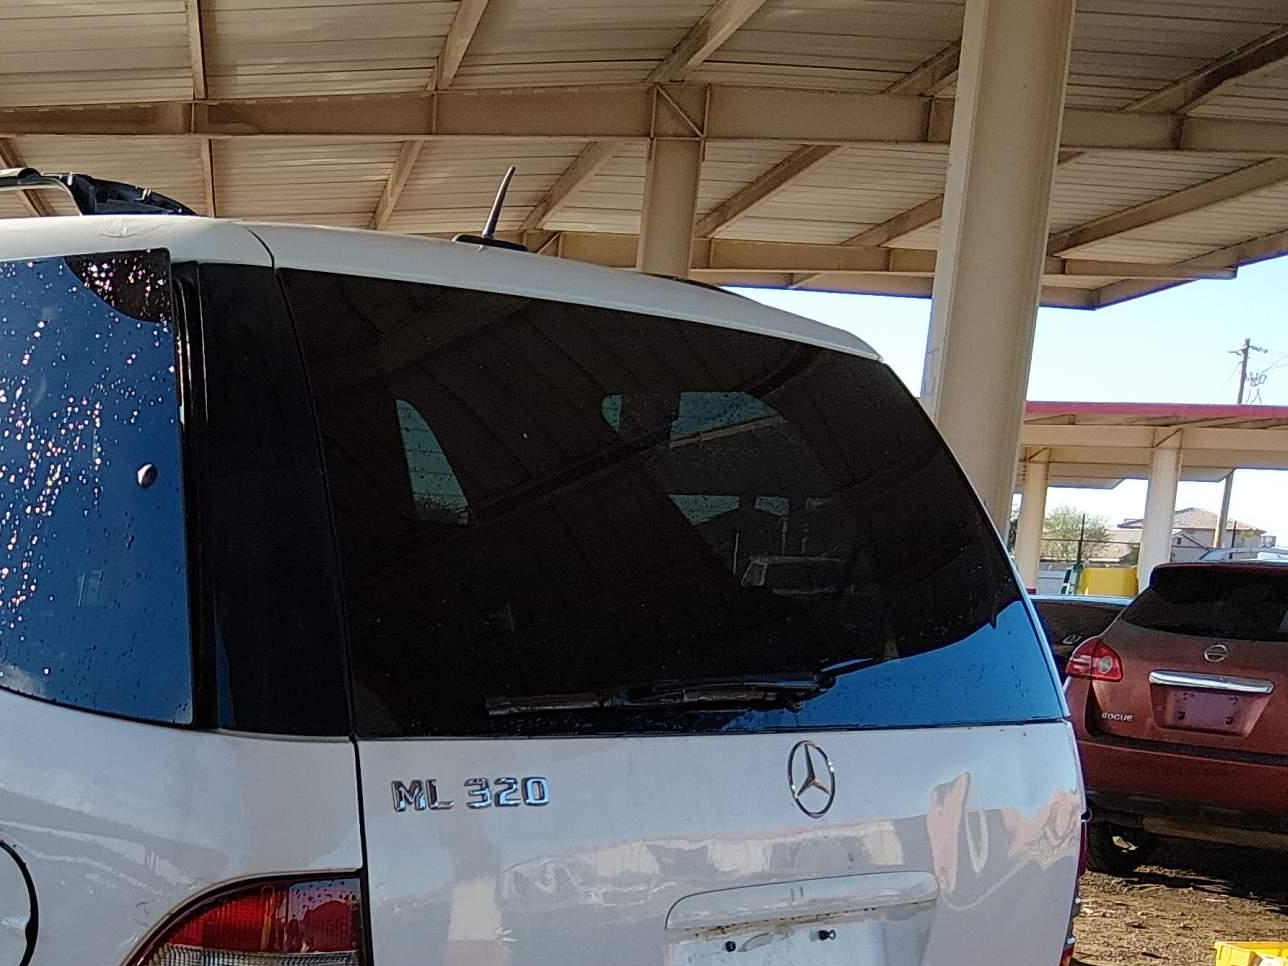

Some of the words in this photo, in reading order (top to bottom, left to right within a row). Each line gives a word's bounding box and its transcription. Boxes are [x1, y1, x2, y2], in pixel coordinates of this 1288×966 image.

[1101, 711, 1133, 721] ROGUE
[391, 778, 454, 812] ML
[464, 776, 550, 810] 320
